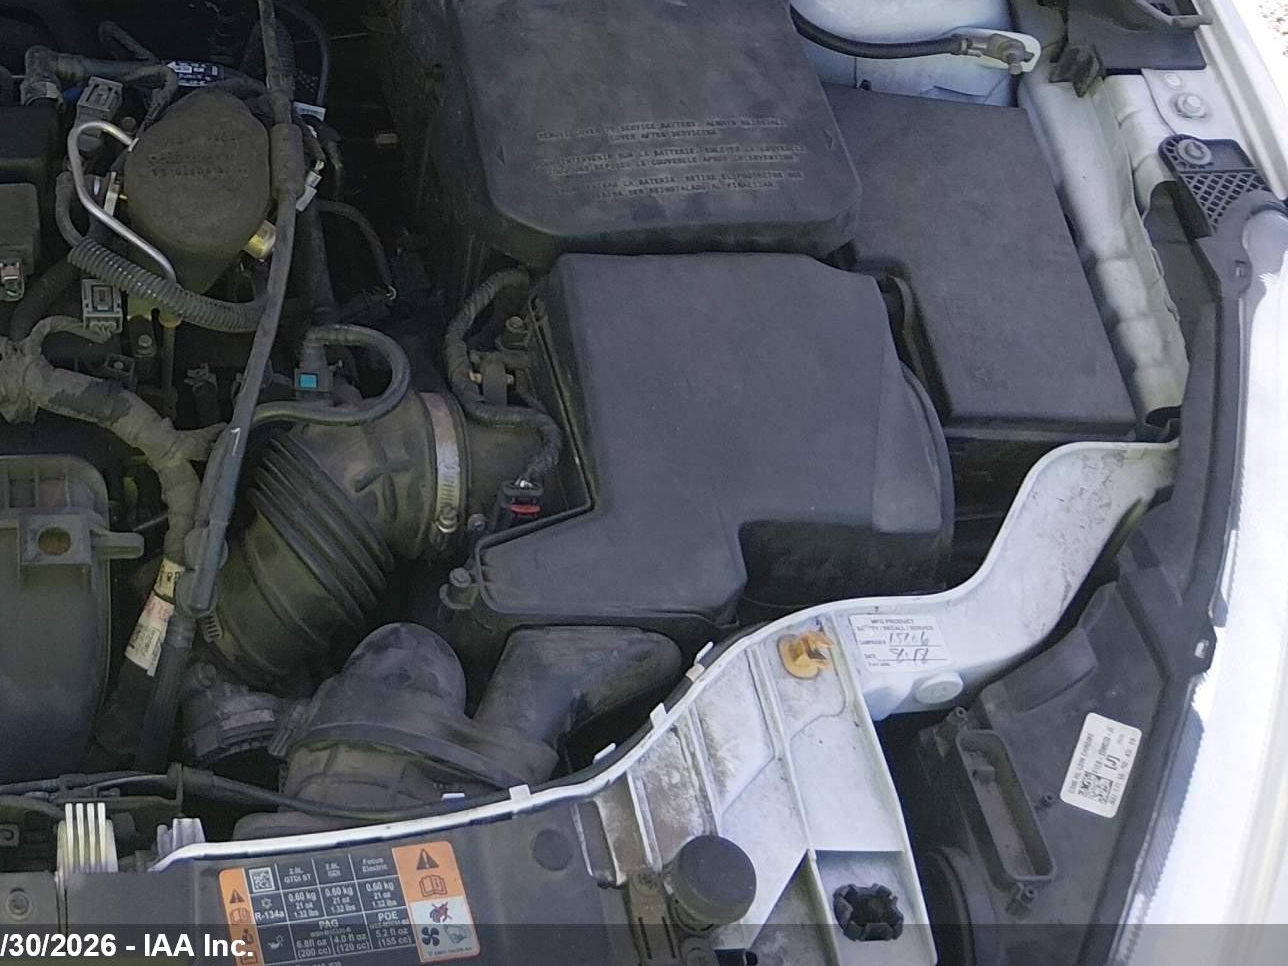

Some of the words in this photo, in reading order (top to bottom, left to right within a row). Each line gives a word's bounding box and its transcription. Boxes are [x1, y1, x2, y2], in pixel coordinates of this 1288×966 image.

[362, 864, 388, 873] Electric
[325, 888, 341, 897] 0.60
[343, 886, 353, 896] kg
[366, 883, 381, 892] 0.60
[383, 882, 395, 891] kg
[288, 894, 304, 902] 0.60
[306, 892, 316, 901] kg
[387, 898, 397, 906] lbs
[254, 910, 284, 922] R-134a
[309, 909, 319, 917] lbs
[378, 911, 399, 922] POE
[318, 919, 339, 929] PAG
[334, 935, 349, 944] 4.0
[358, 933, 367, 941] oz
[376, 930, 388, 939] 5.2
[336, 943, 355, 953] (120
[356, 940, 371, 951] cc)
[378, 938, 397, 948] (155
[398, 936, 412, 946] cc)
[297, 947, 316, 958] (200
[317, 945, 331, 955] cc)
